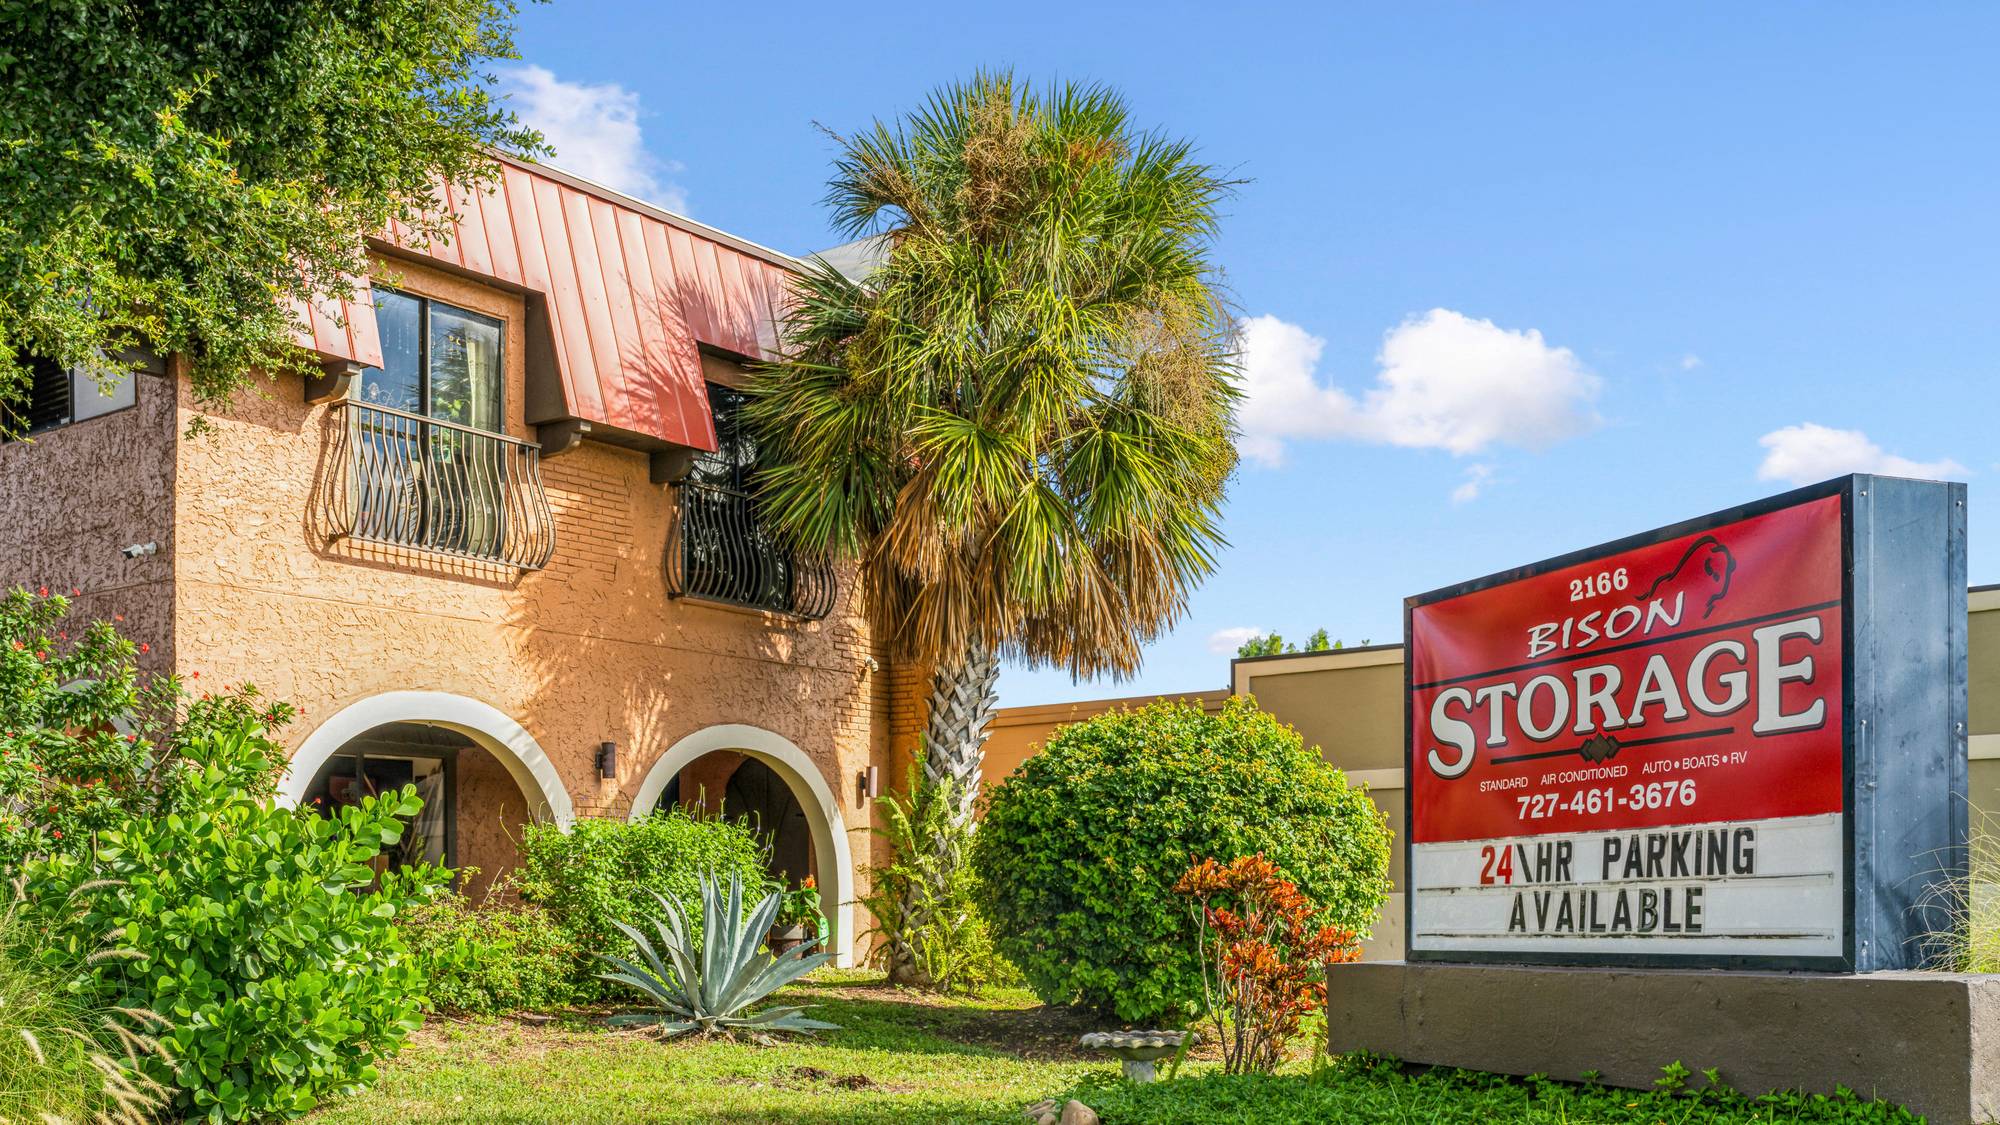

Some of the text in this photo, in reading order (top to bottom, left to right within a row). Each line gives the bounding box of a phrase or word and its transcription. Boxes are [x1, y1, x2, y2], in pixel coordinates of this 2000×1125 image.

[1569, 567, 1629, 602] 2166
[1527, 591, 1685, 658] BISON
[1427, 616, 1827, 779] STORAGE
[1479, 750, 1748, 793] STANDARD AIR CONDITIONED AUTO BOATS RV
[1517, 779, 1697, 820] 727-461-3676
[1602, 828, 1757, 881] PARKING
[1508, 887, 1704, 934] AVAILABLE
